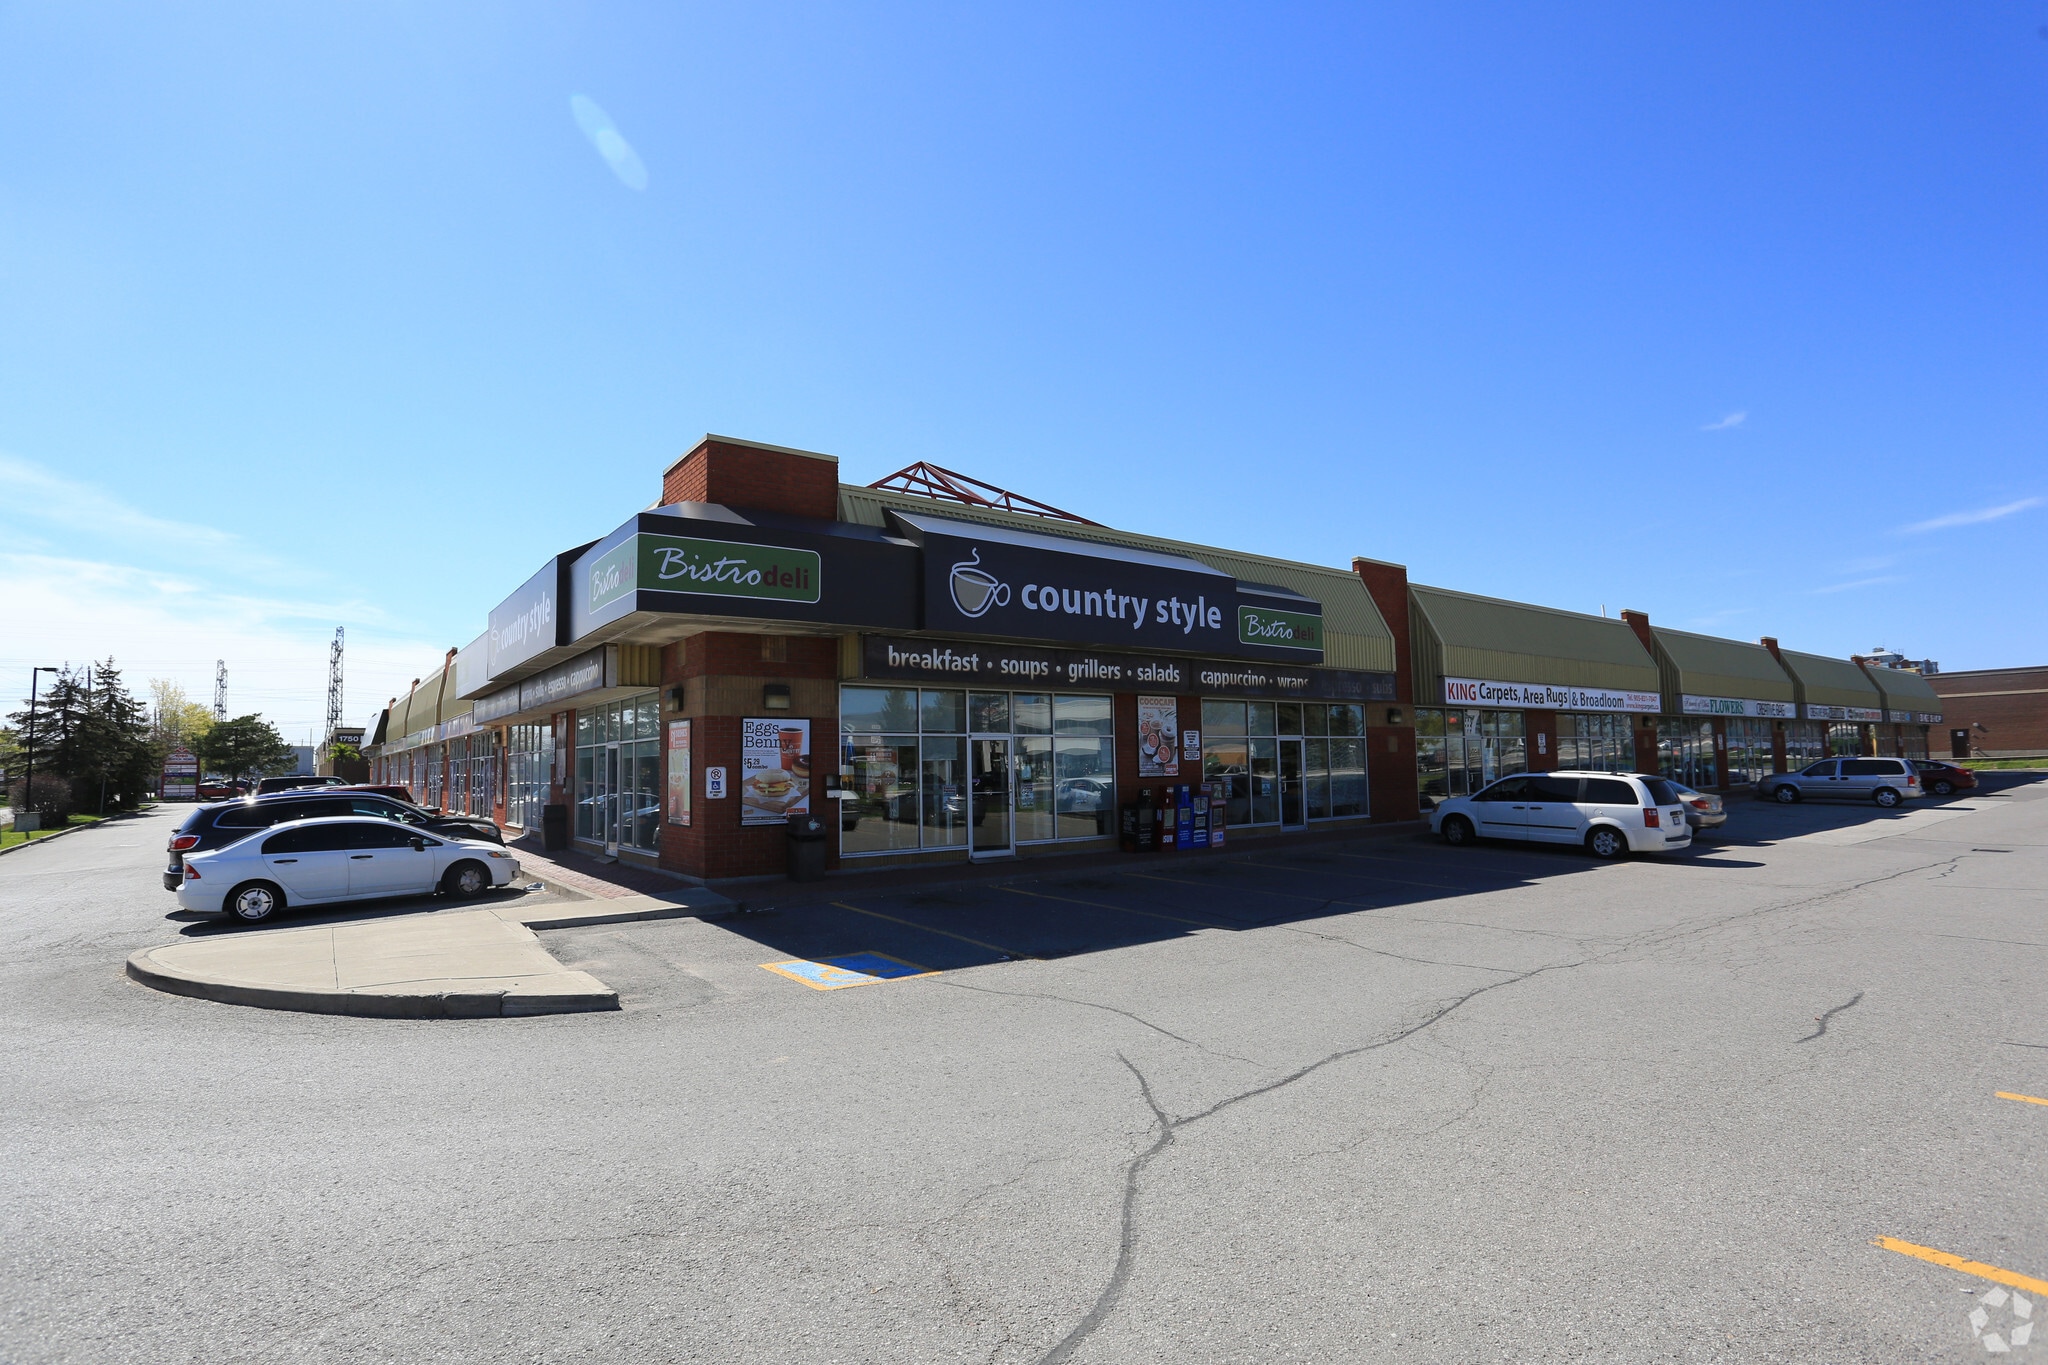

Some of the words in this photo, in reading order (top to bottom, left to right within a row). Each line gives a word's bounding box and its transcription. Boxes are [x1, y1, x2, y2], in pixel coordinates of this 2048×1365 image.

[1021, 582, 1150, 630] country
[1156, 594, 1222, 634] style
[501, 611, 528, 650] country
[529, 591, 550, 636] style
[888, 645, 979, 672] breakfast
[1000, 659, 1048, 680] soups
[1068, 659, 1121, 682] grillers
[1137, 663, 1180, 683] salads
[1200, 668, 1266, 689] cappuccino
[1447, 682, 1477, 701] KING
[1479, 683, 1521, 705] Carpets,
[1523, 688, 1545, 704] Area
[1546, 687, 1568, 706] Rugs
[1571, 692, 1579, 706] &
[1580, 692, 1625, 709] Broadloom
[1710, 699, 1744, 715] FLOWERS
[339, 735, 359, 743] 1750
[744, 721, 780, 737] Eggs
[744, 736, 793, 751] Benny
